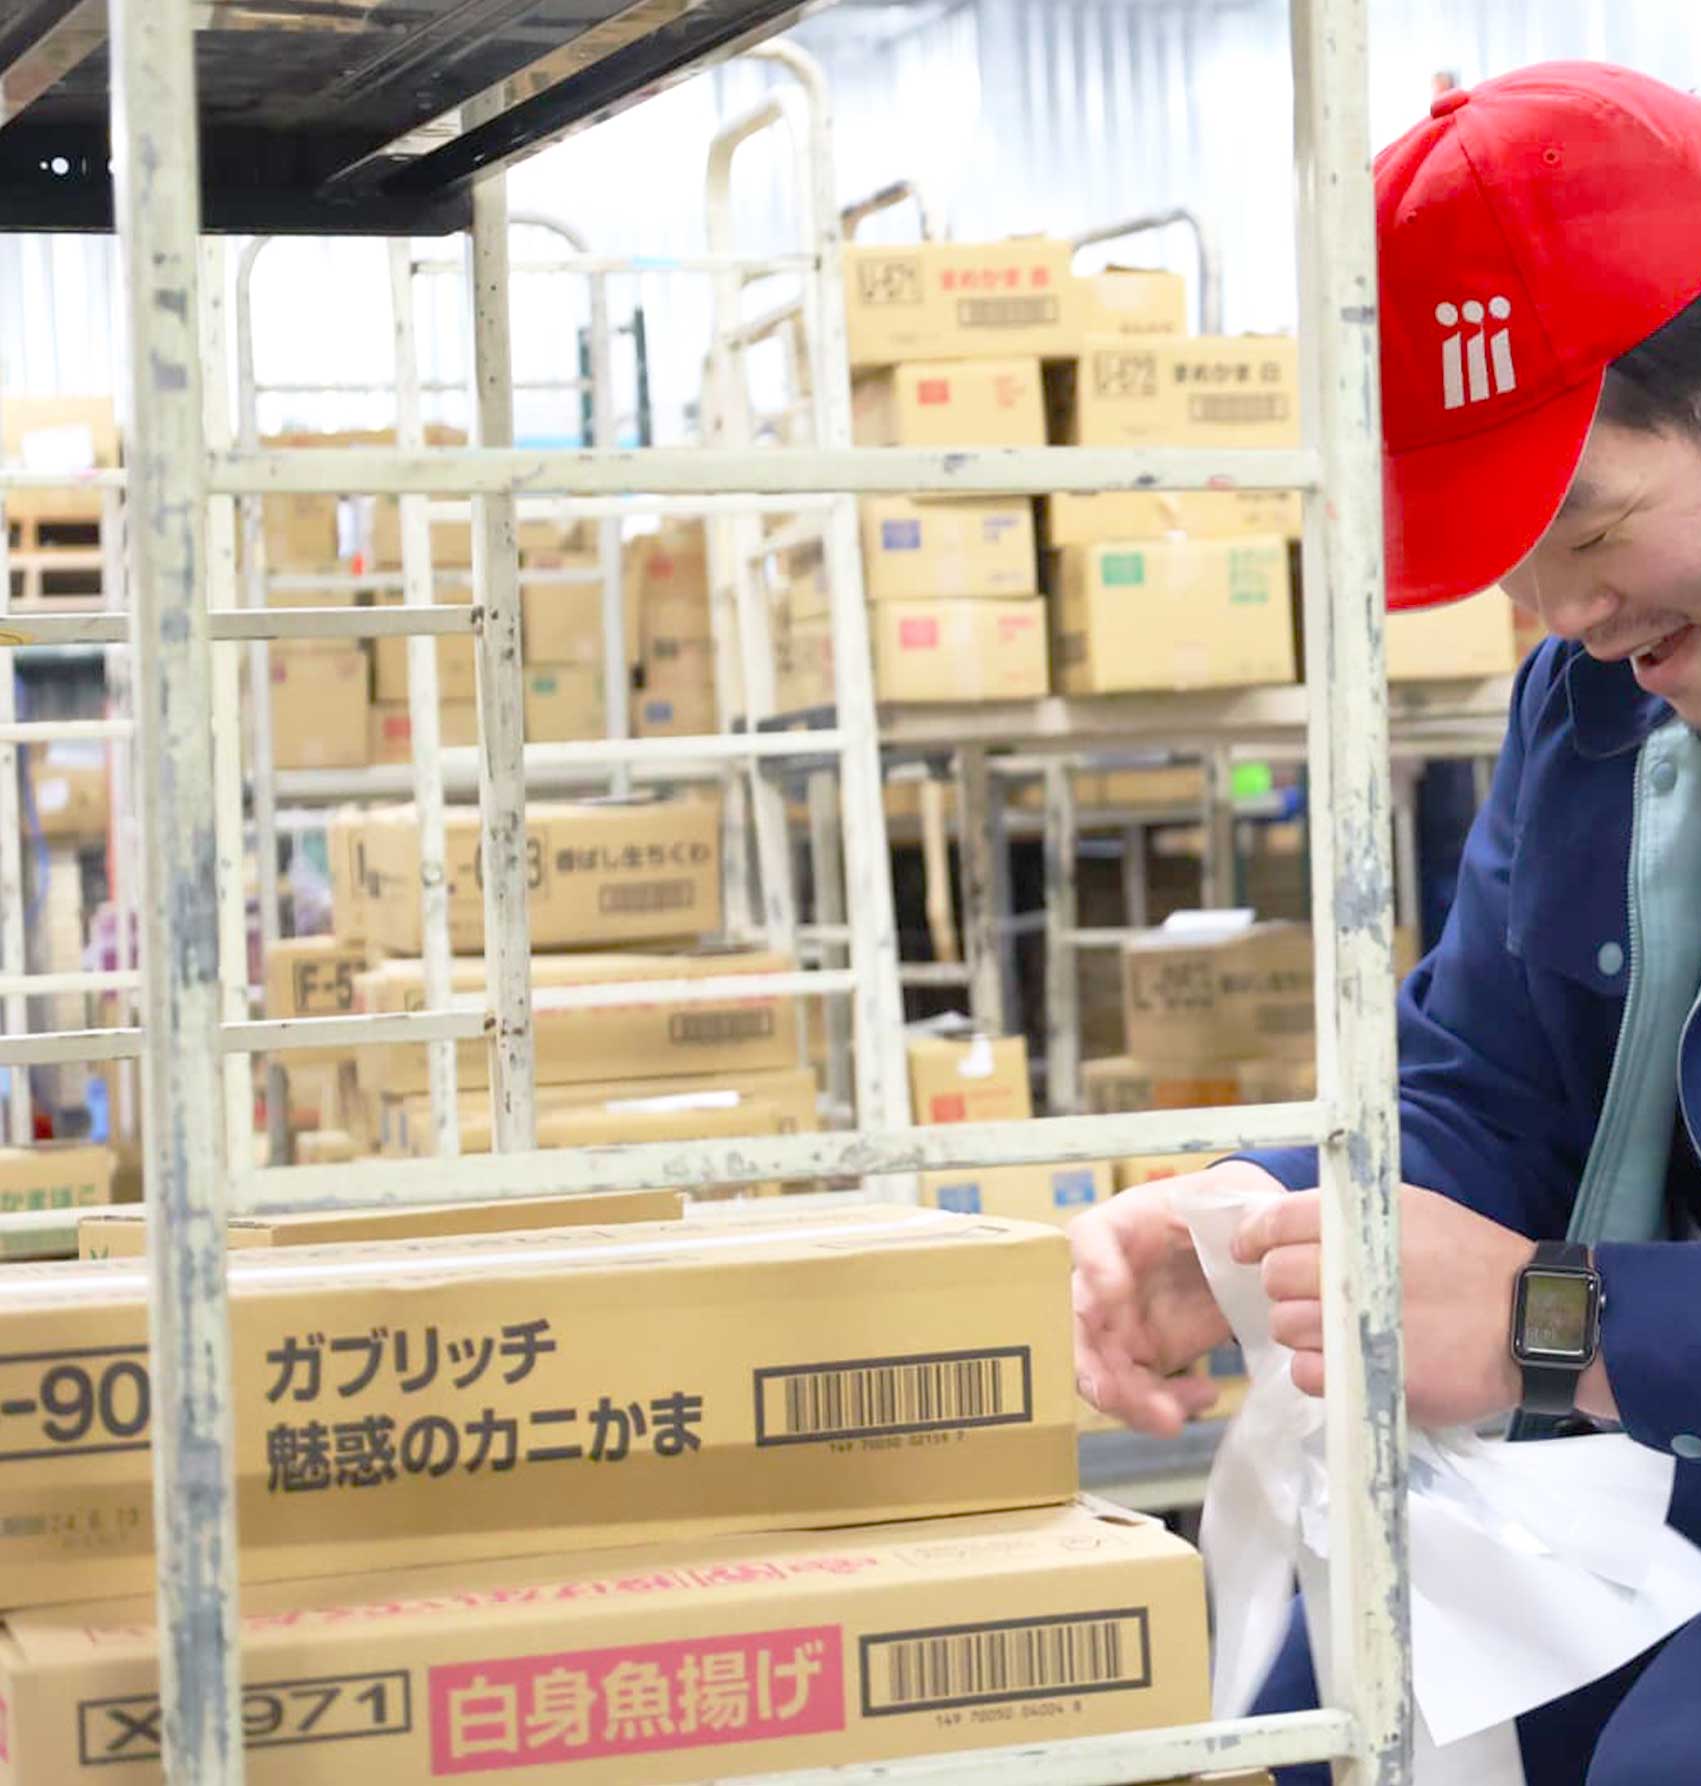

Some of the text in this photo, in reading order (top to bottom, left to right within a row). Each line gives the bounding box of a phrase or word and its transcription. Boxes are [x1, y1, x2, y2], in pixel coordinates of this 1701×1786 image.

[266, 1318, 557, 1404] ガブリッチ
[266, 1391, 704, 1493] 魅惑のカニかま
[106, 1683, 388, 1752] X971
[446, 1639, 826, 1760] 白身魚揚げ
